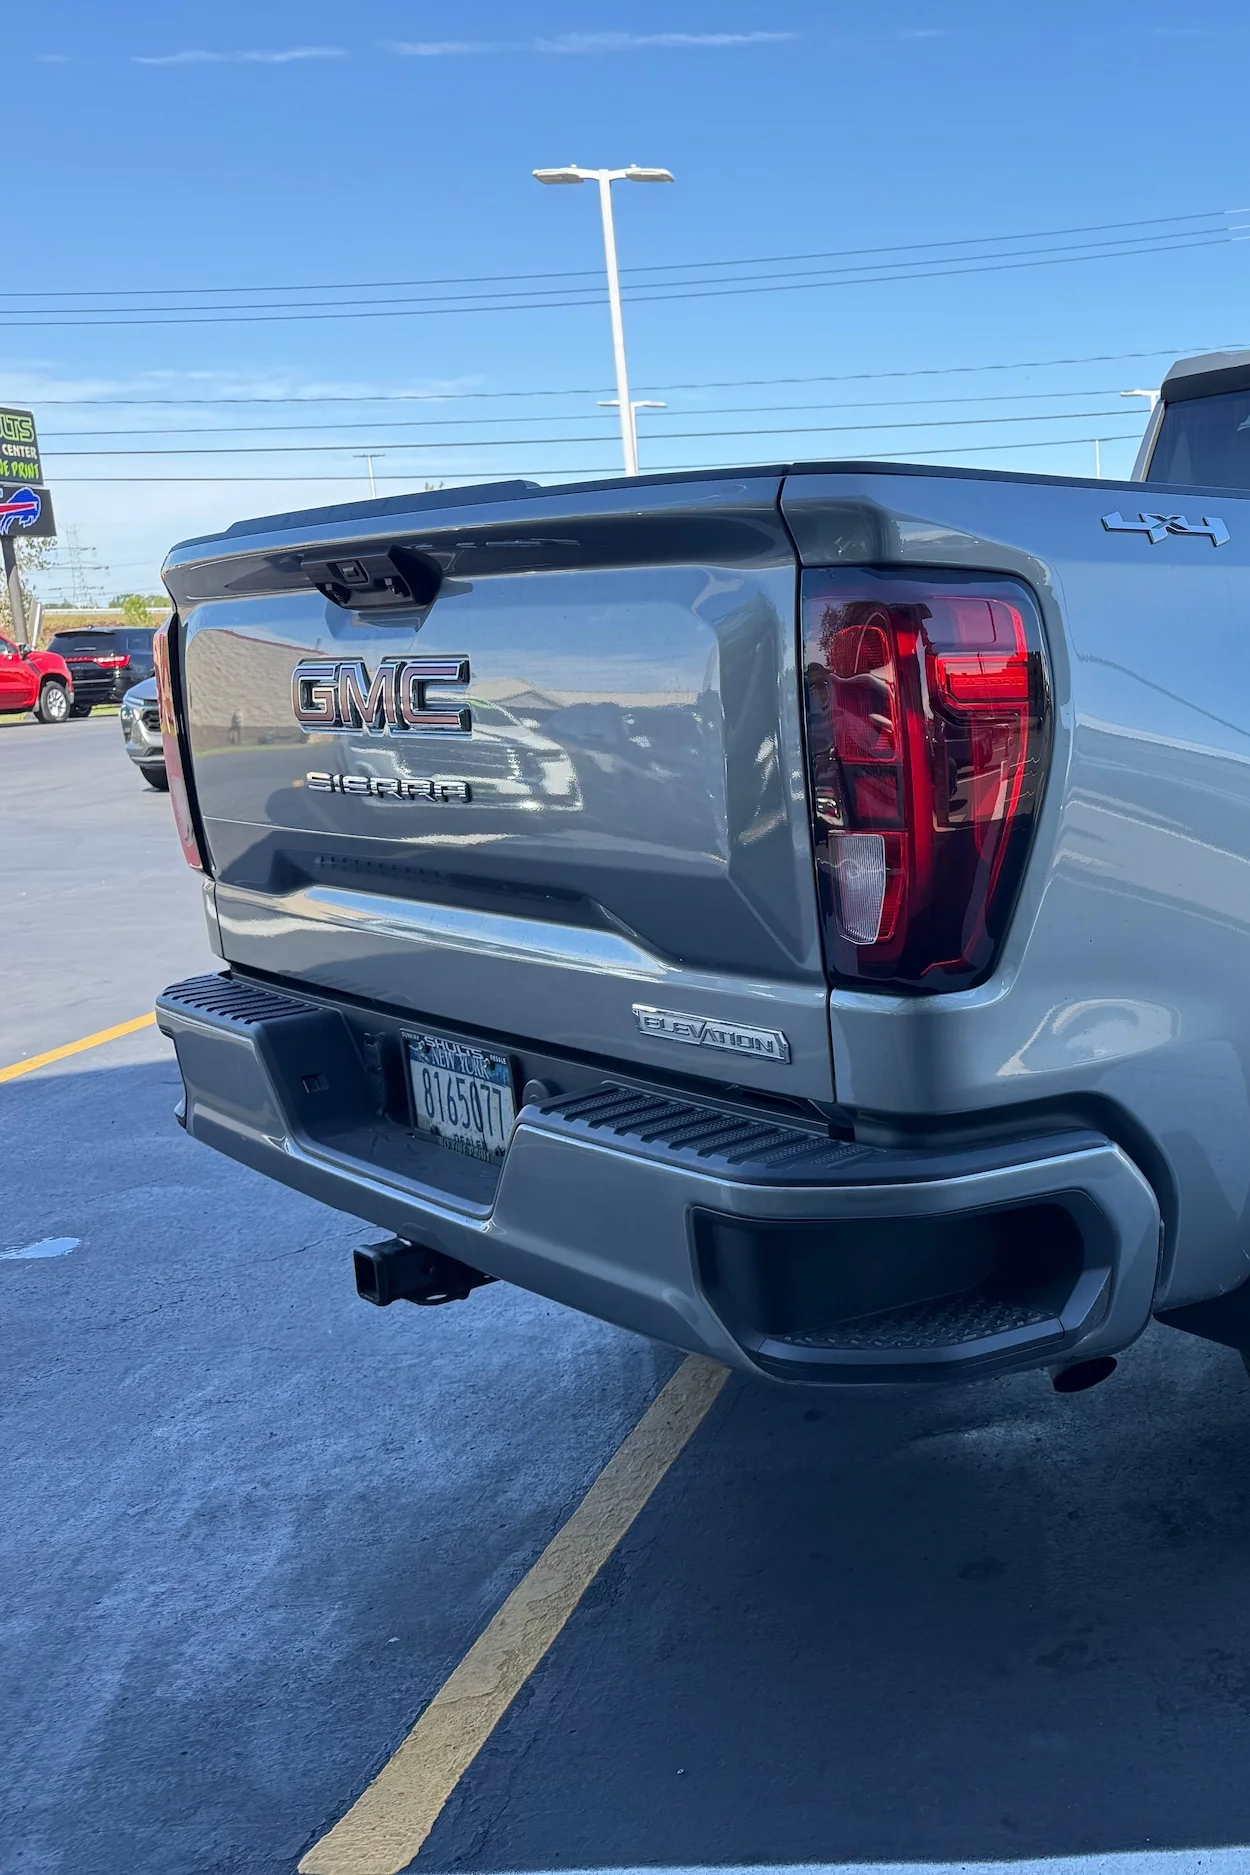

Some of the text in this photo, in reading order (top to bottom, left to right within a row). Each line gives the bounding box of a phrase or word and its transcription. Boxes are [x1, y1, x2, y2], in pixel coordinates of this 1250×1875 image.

[2, 444, 38, 460] CENTER
[11, 461, 39, 480] PRINT
[291, 654, 472, 740] GMC
[306, 771, 473, 803] SIERRA
[424, 1036, 484, 1059] SHULTS
[643, 1016, 774, 1054] ELEVATION
[431, 1047, 490, 1080] NEW YORK
[422, 1067, 505, 1141] 8165077
